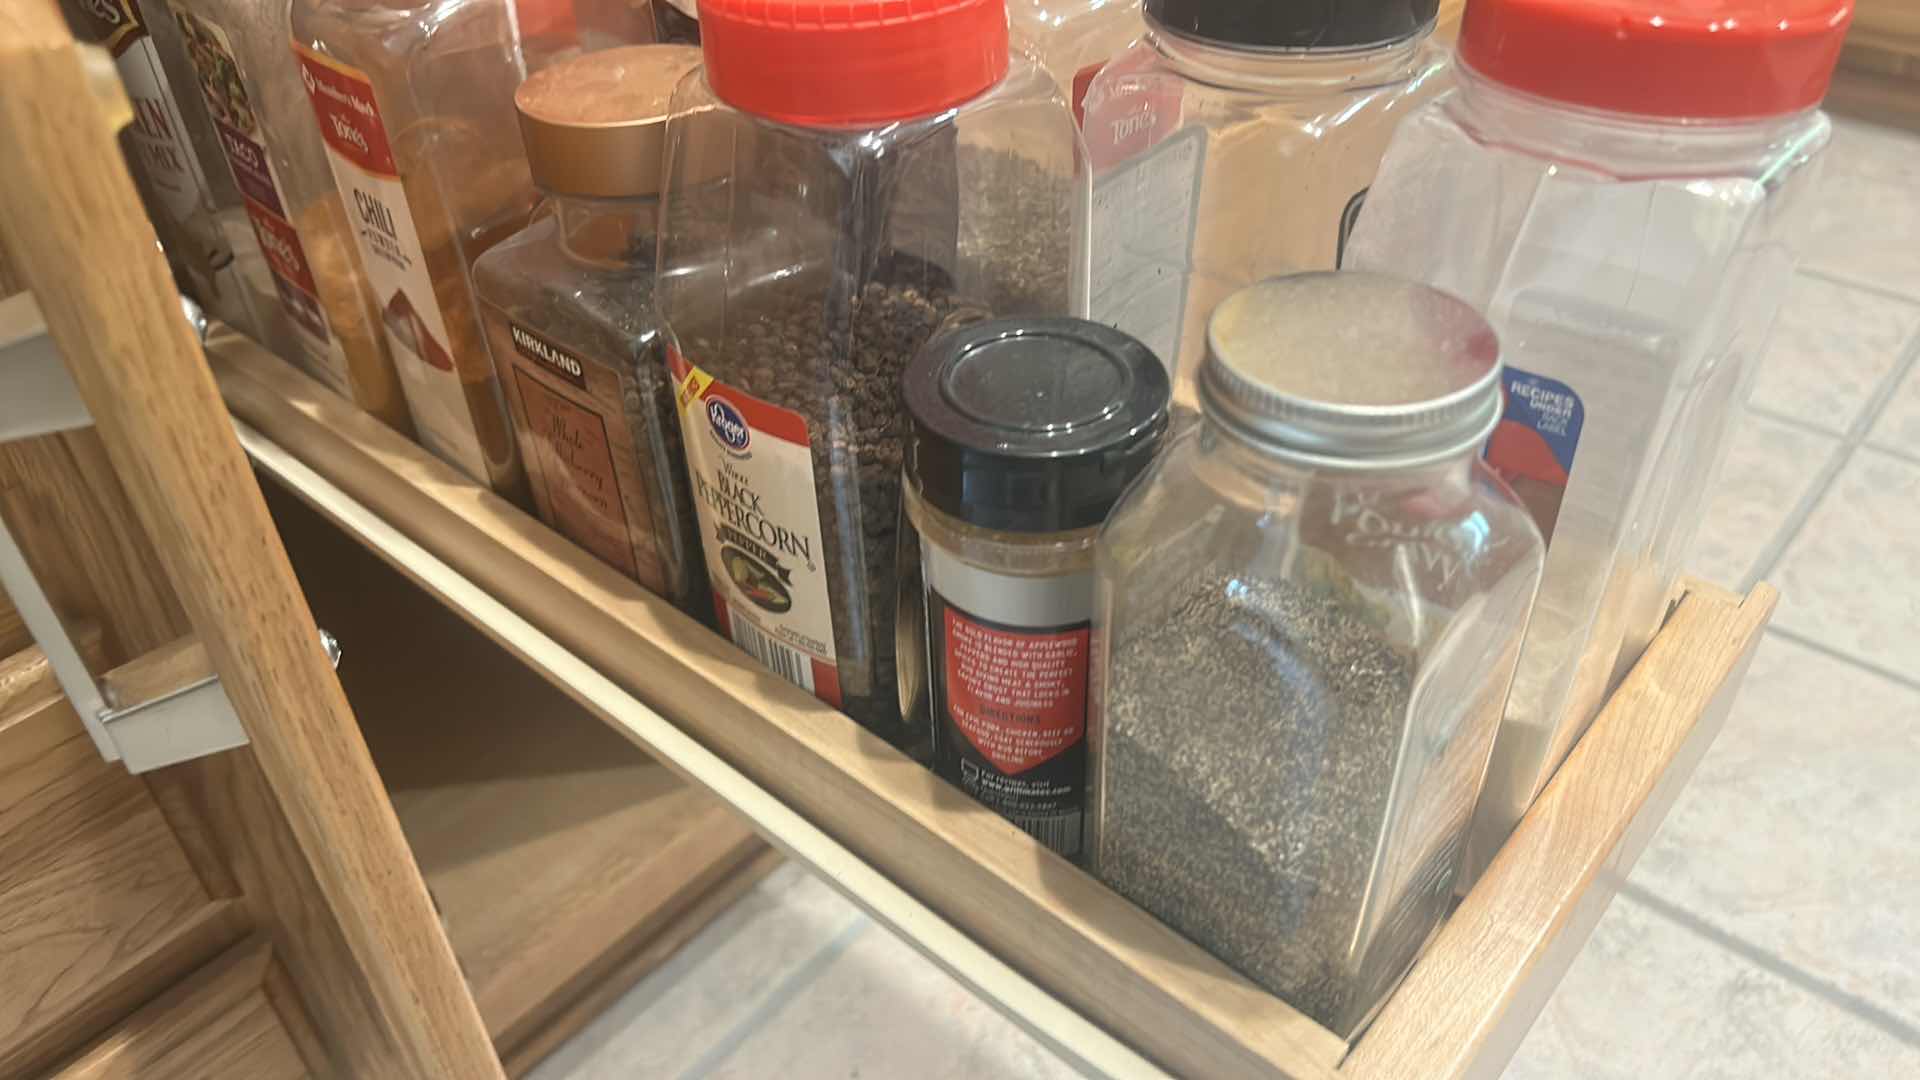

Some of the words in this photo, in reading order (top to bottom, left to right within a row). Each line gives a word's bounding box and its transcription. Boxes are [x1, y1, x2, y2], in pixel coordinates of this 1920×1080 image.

[353, 188, 398, 241] CHILI
[512, 326, 582, 377] KIRKLAND
[1511, 380, 1574, 409] RECIPES
[710, 403, 745, 443] Kroger
[694, 471, 812, 563] PEPPERCORN
[717, 469, 766, 517] BLACK
